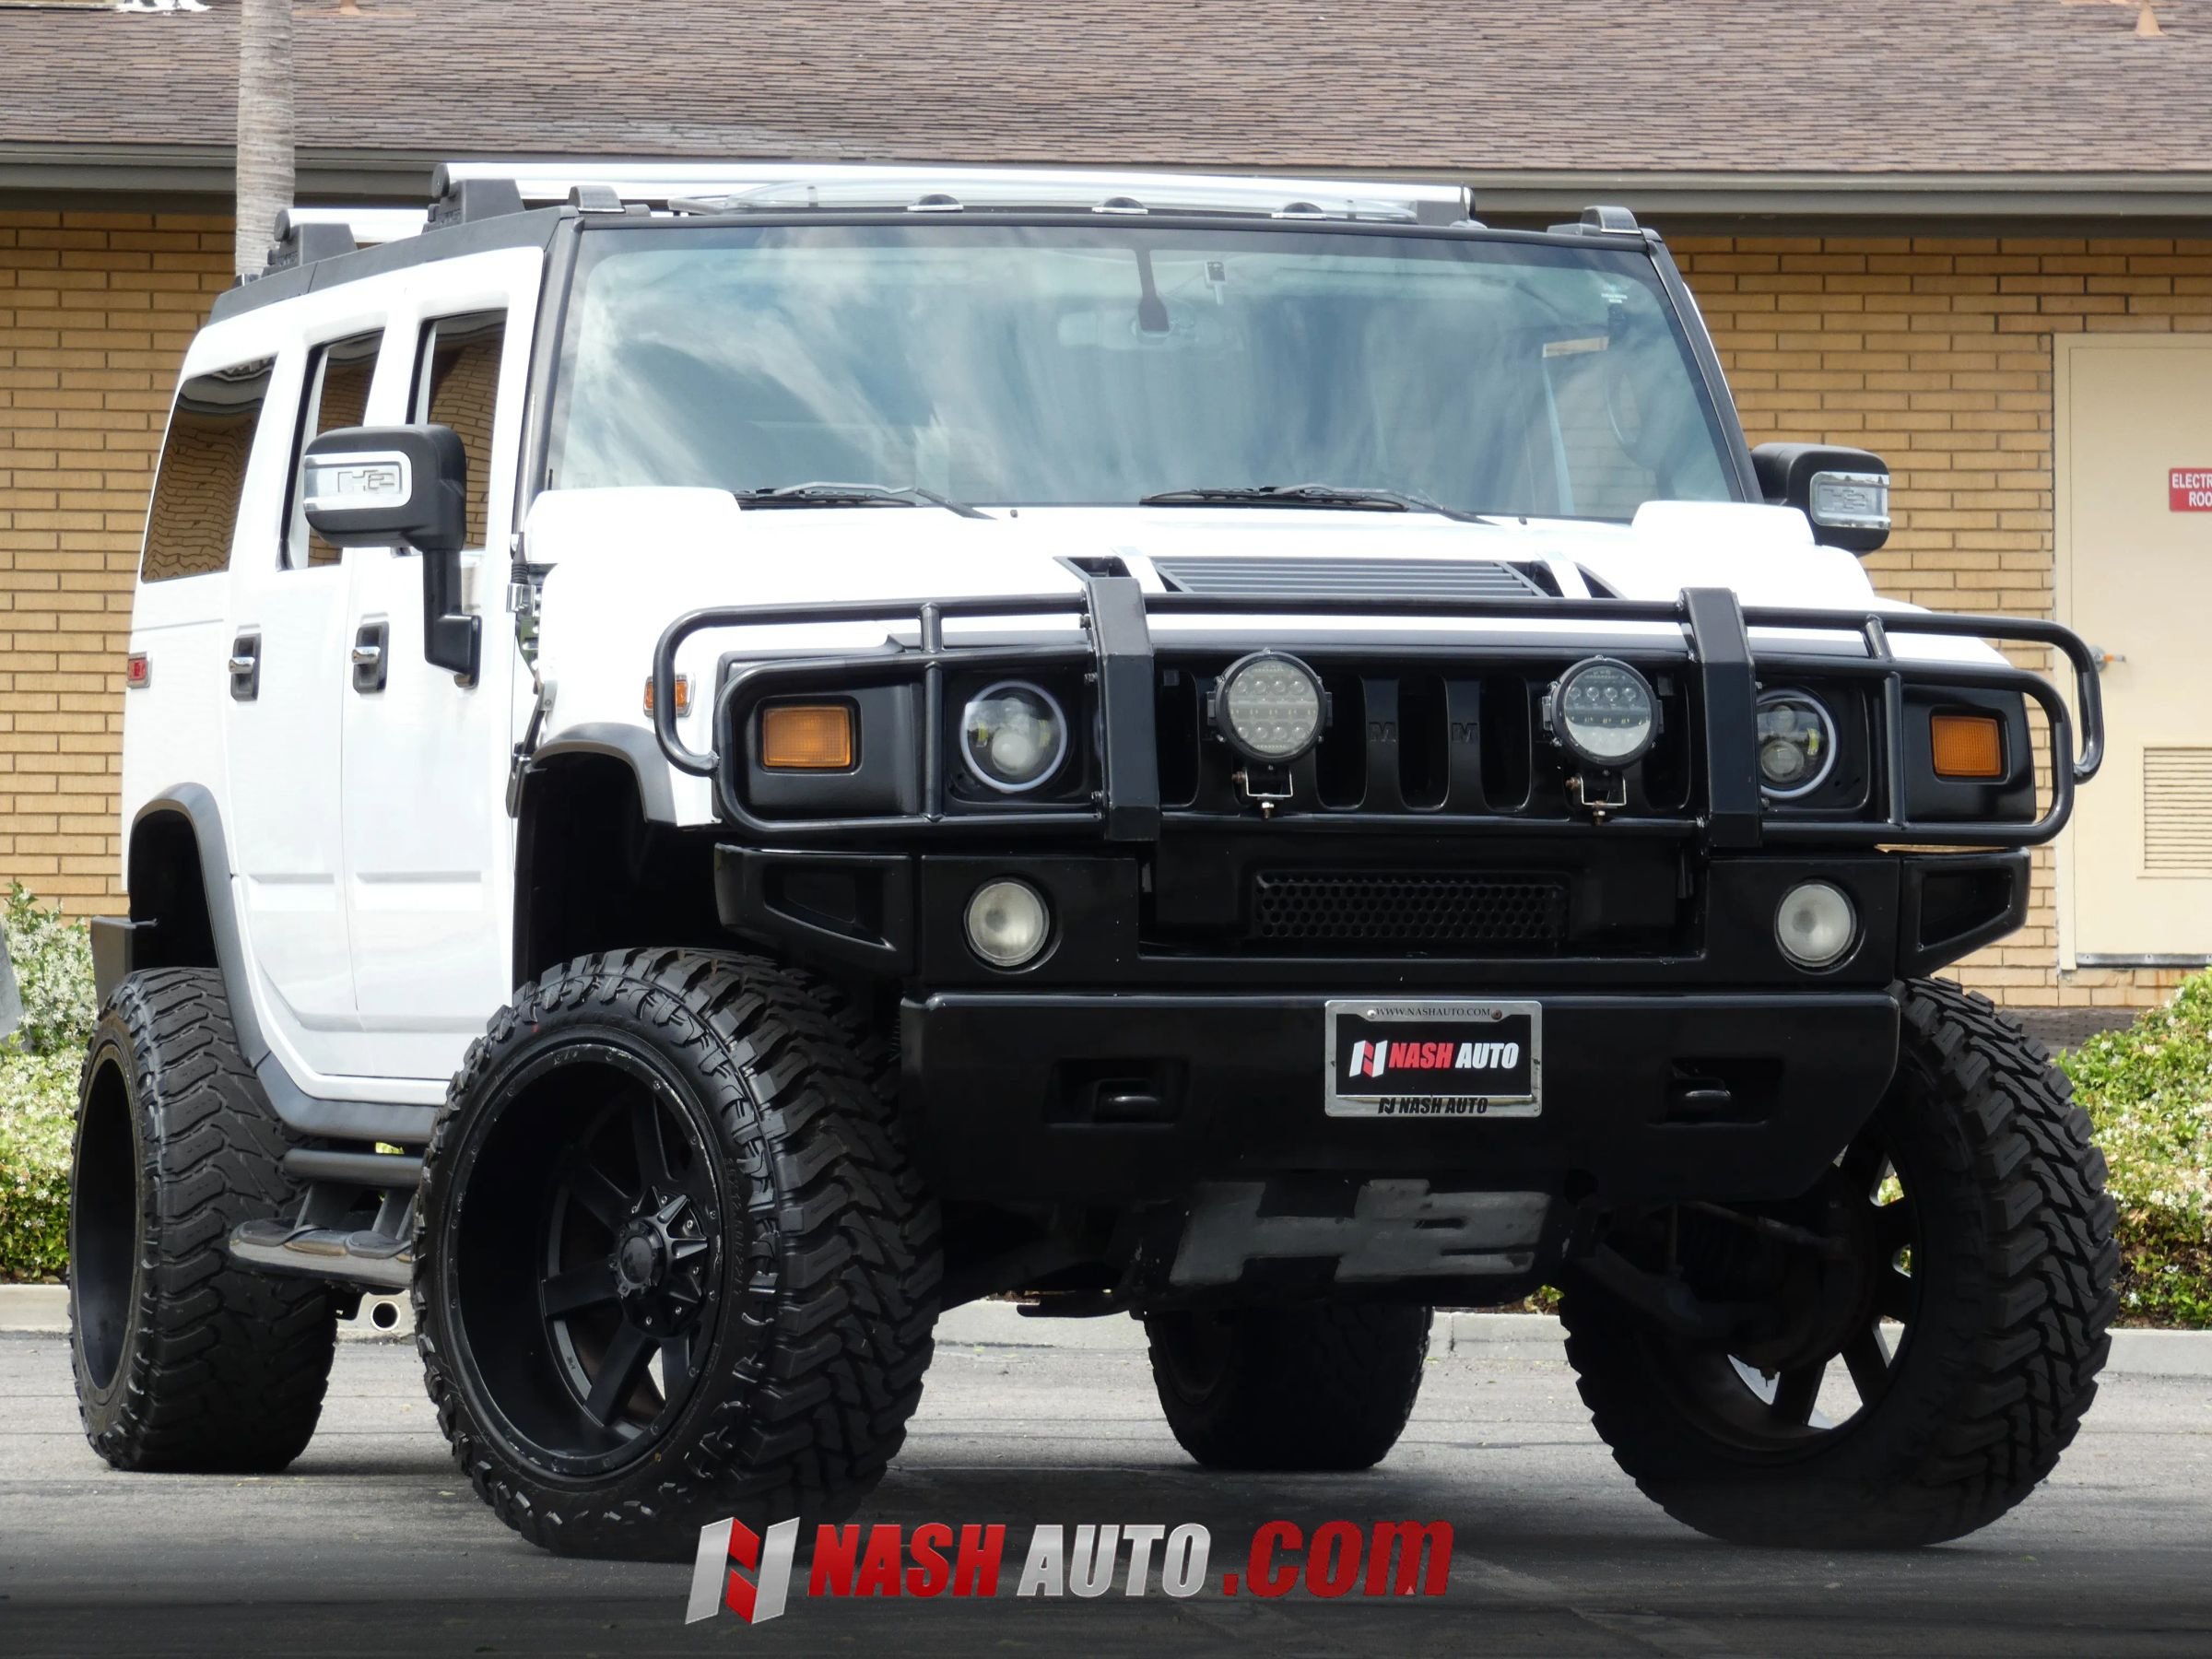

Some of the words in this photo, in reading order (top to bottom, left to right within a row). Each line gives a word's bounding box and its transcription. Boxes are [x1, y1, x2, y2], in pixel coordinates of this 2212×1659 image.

[1375, 1006, 1491, 1018] WWW.NASHAUTO.COM
[1389, 1042, 1454, 1069] NASH
[1454, 1042, 1520, 1069] AUTO
[1398, 1098, 1444, 1114] NASH
[1444, 1097, 1488, 1114] AUTO
